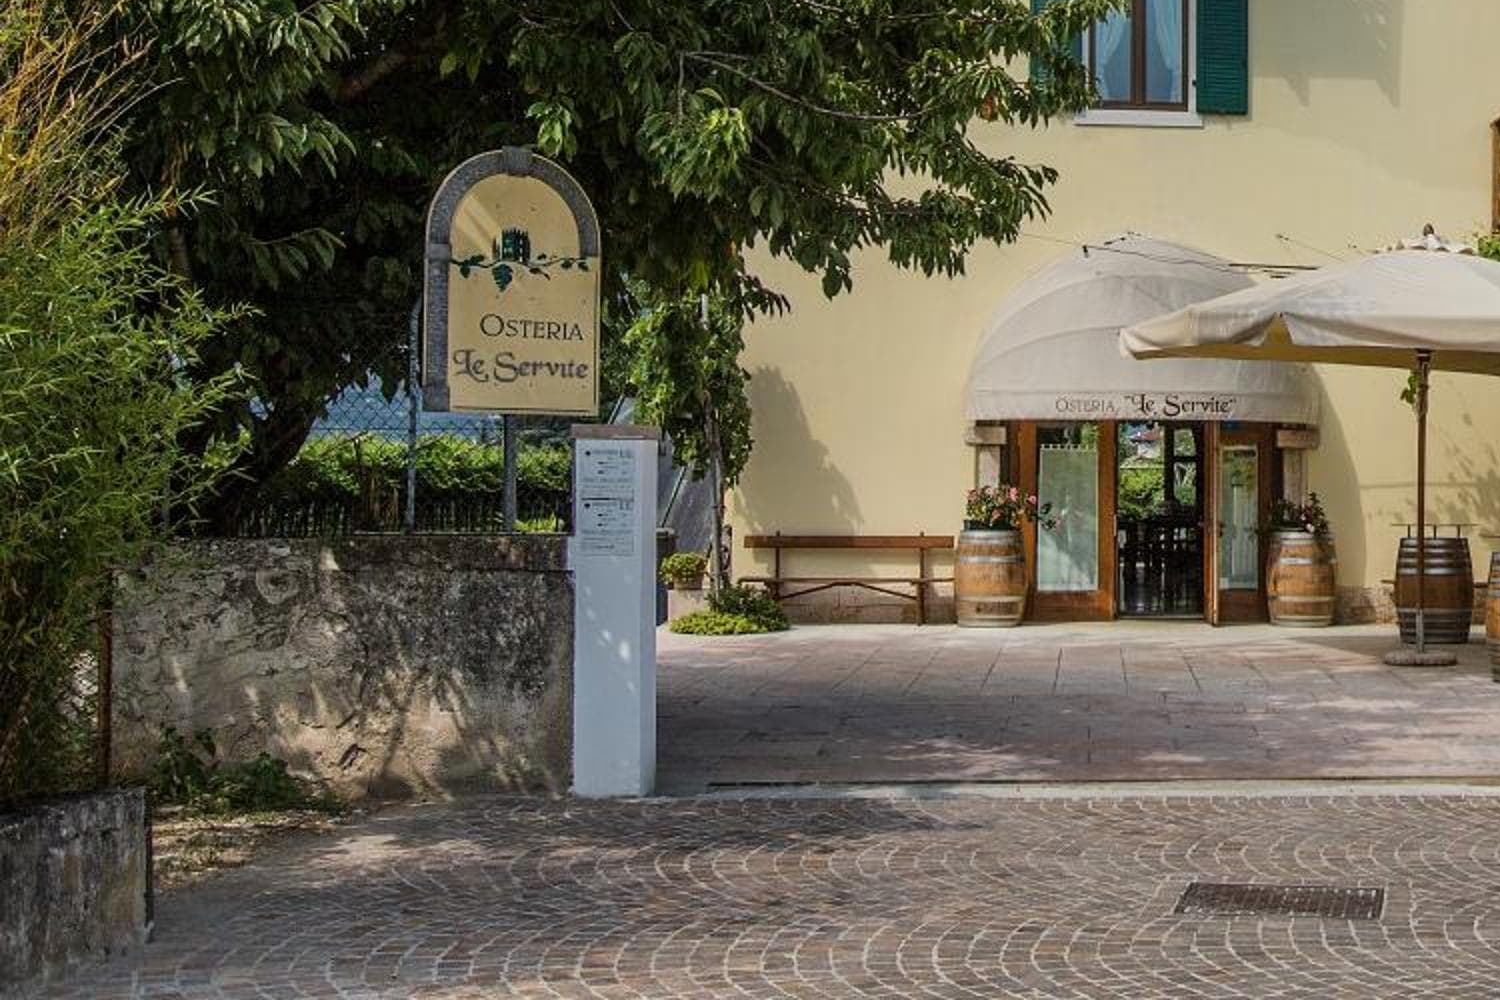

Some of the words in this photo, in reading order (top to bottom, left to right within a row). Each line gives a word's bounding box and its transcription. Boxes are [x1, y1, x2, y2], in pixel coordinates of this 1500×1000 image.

[480, 313, 583, 341] OSTERIA
[453, 349, 490, 383] Le
[494, 351, 589, 382] Servite
